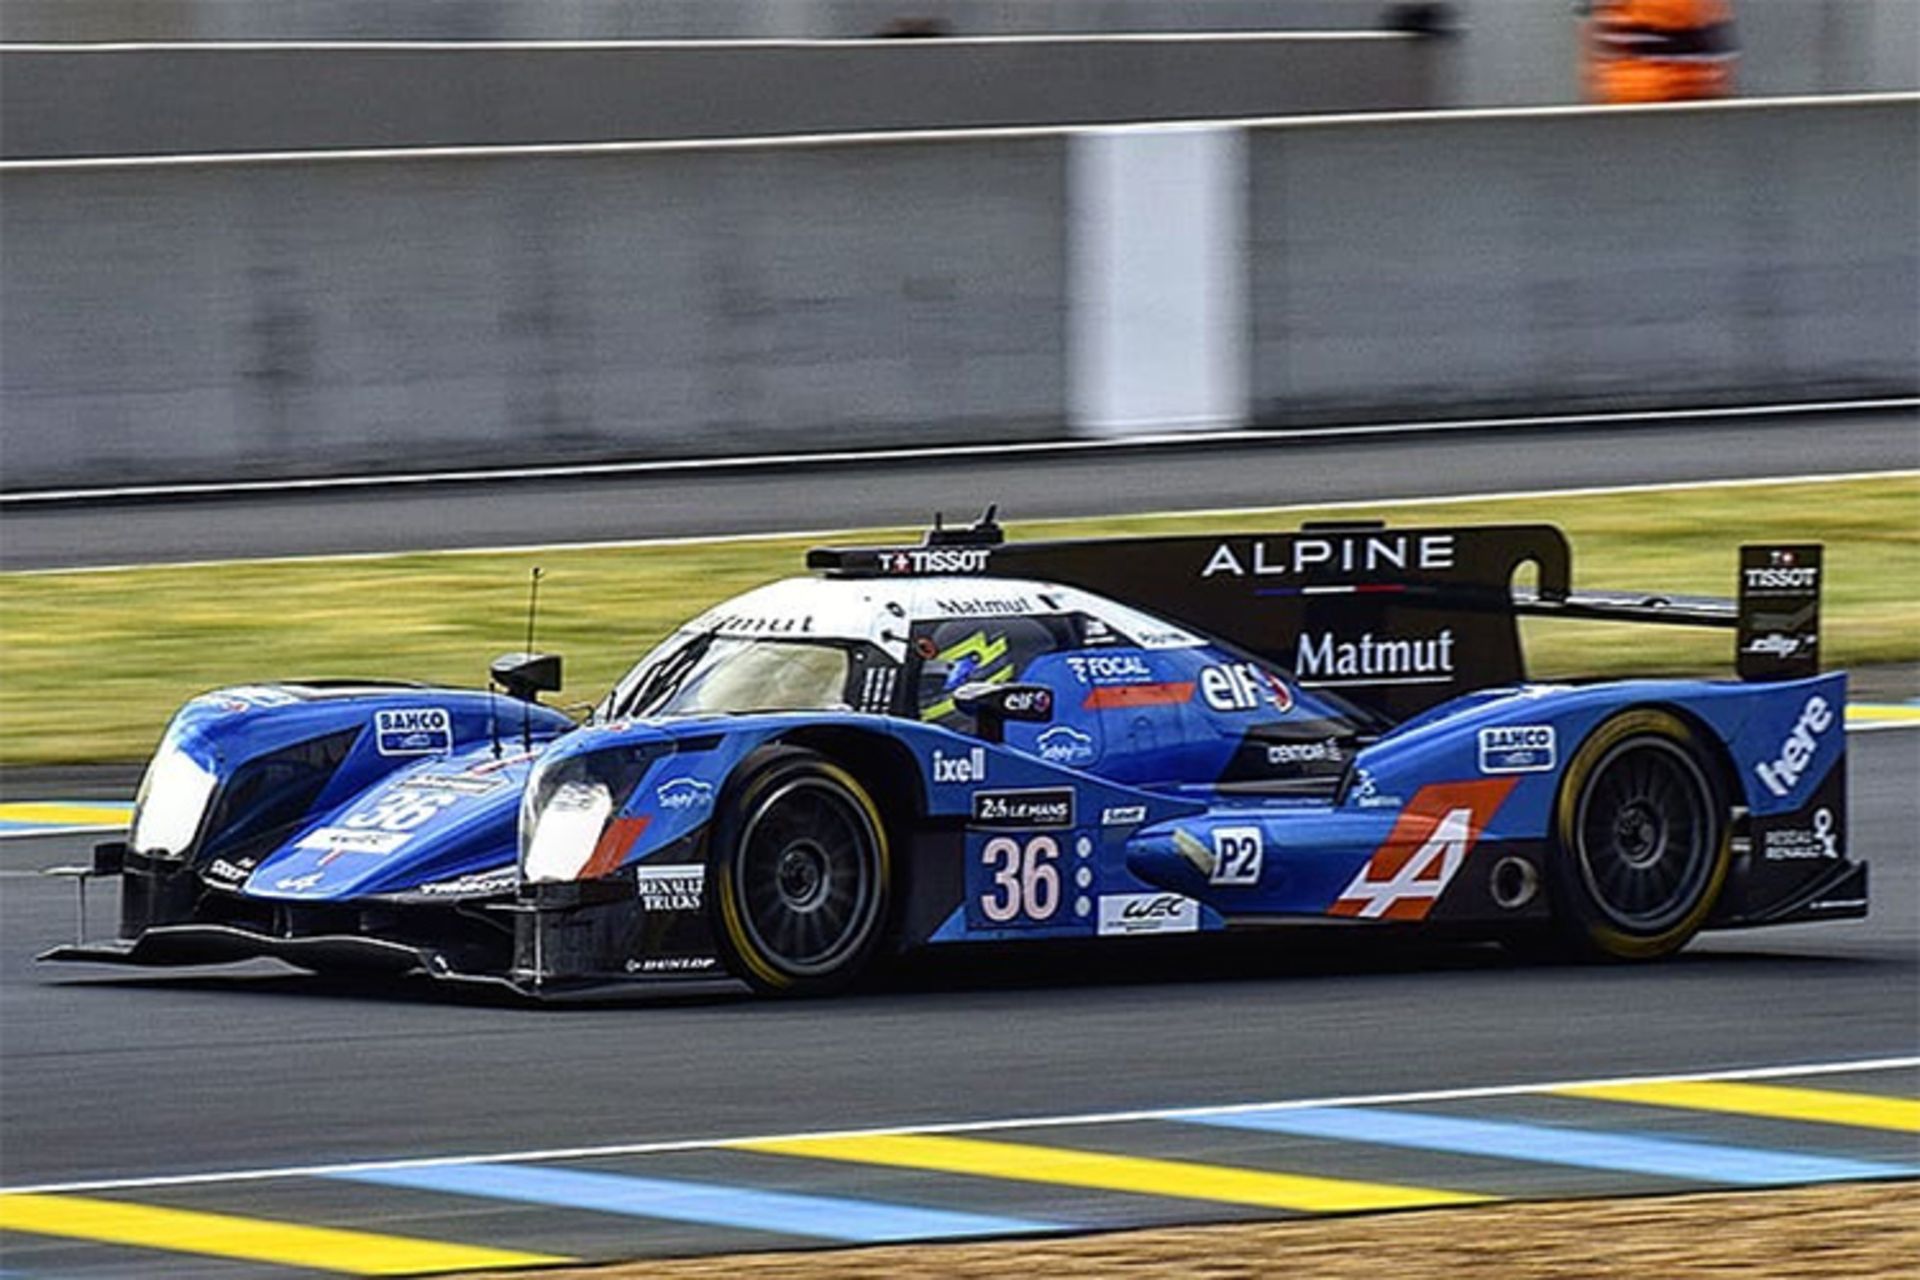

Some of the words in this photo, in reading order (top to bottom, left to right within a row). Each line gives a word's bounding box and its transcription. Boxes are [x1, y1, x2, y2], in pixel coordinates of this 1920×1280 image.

[910, 550, 991, 573] TISSOT
[1202, 536, 1454, 577] ALPINE
[1744, 568, 1818, 587] TISSOT
[936, 598, 1033, 615] Matmut
[1296, 629, 1455, 676] Matmut
[1087, 656, 1151, 677] FOCAL
[1201, 661, 1262, 711] elf
[1003, 691, 1035, 711] elf
[380, 711, 445, 730] BAHCO
[1485, 729, 1550, 748] BAHCO
[1754, 695, 1834, 796] here
[933, 747, 986, 782] ixell
[1215, 836, 1258, 879] P2
[981, 836, 1060, 922] 36
[1122, 896, 1186, 918] WEC
[642, 958, 716, 972] DUNLOP
